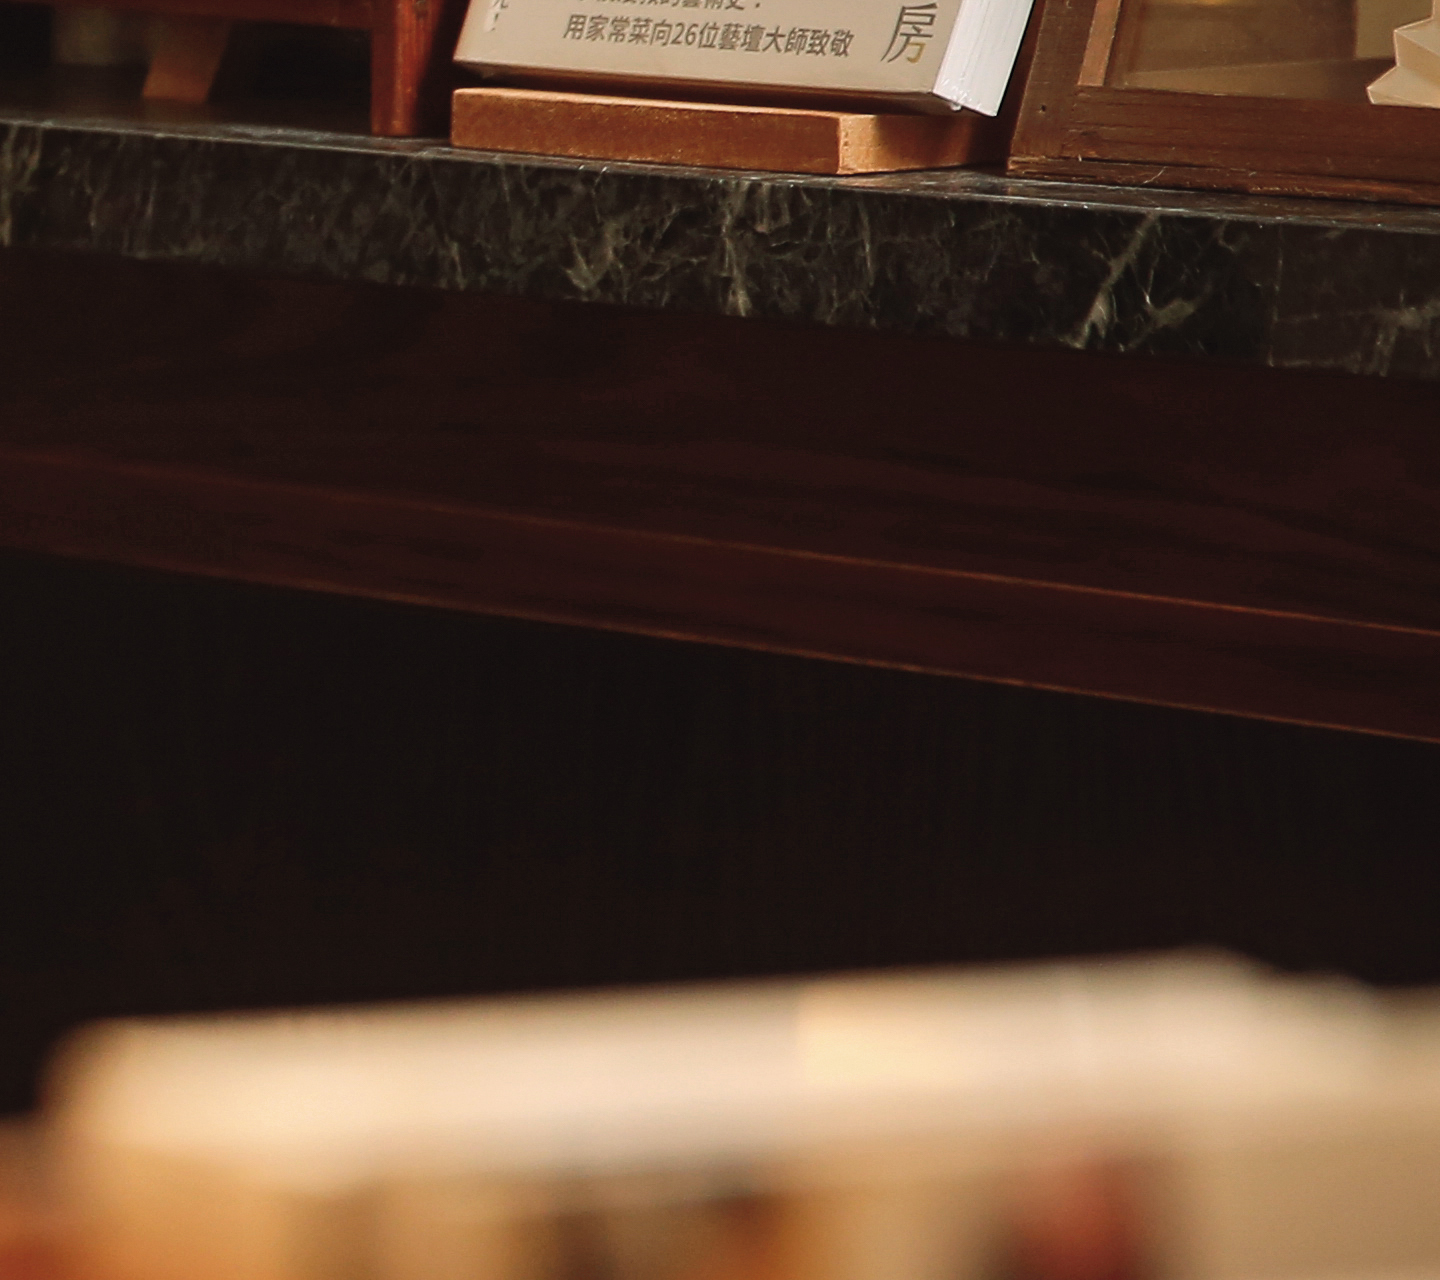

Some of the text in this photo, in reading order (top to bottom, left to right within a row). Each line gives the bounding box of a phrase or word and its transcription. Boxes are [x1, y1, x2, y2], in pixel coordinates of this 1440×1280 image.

[563, 13, 854, 59] 用家常菜向26位藝壇大師致敬
